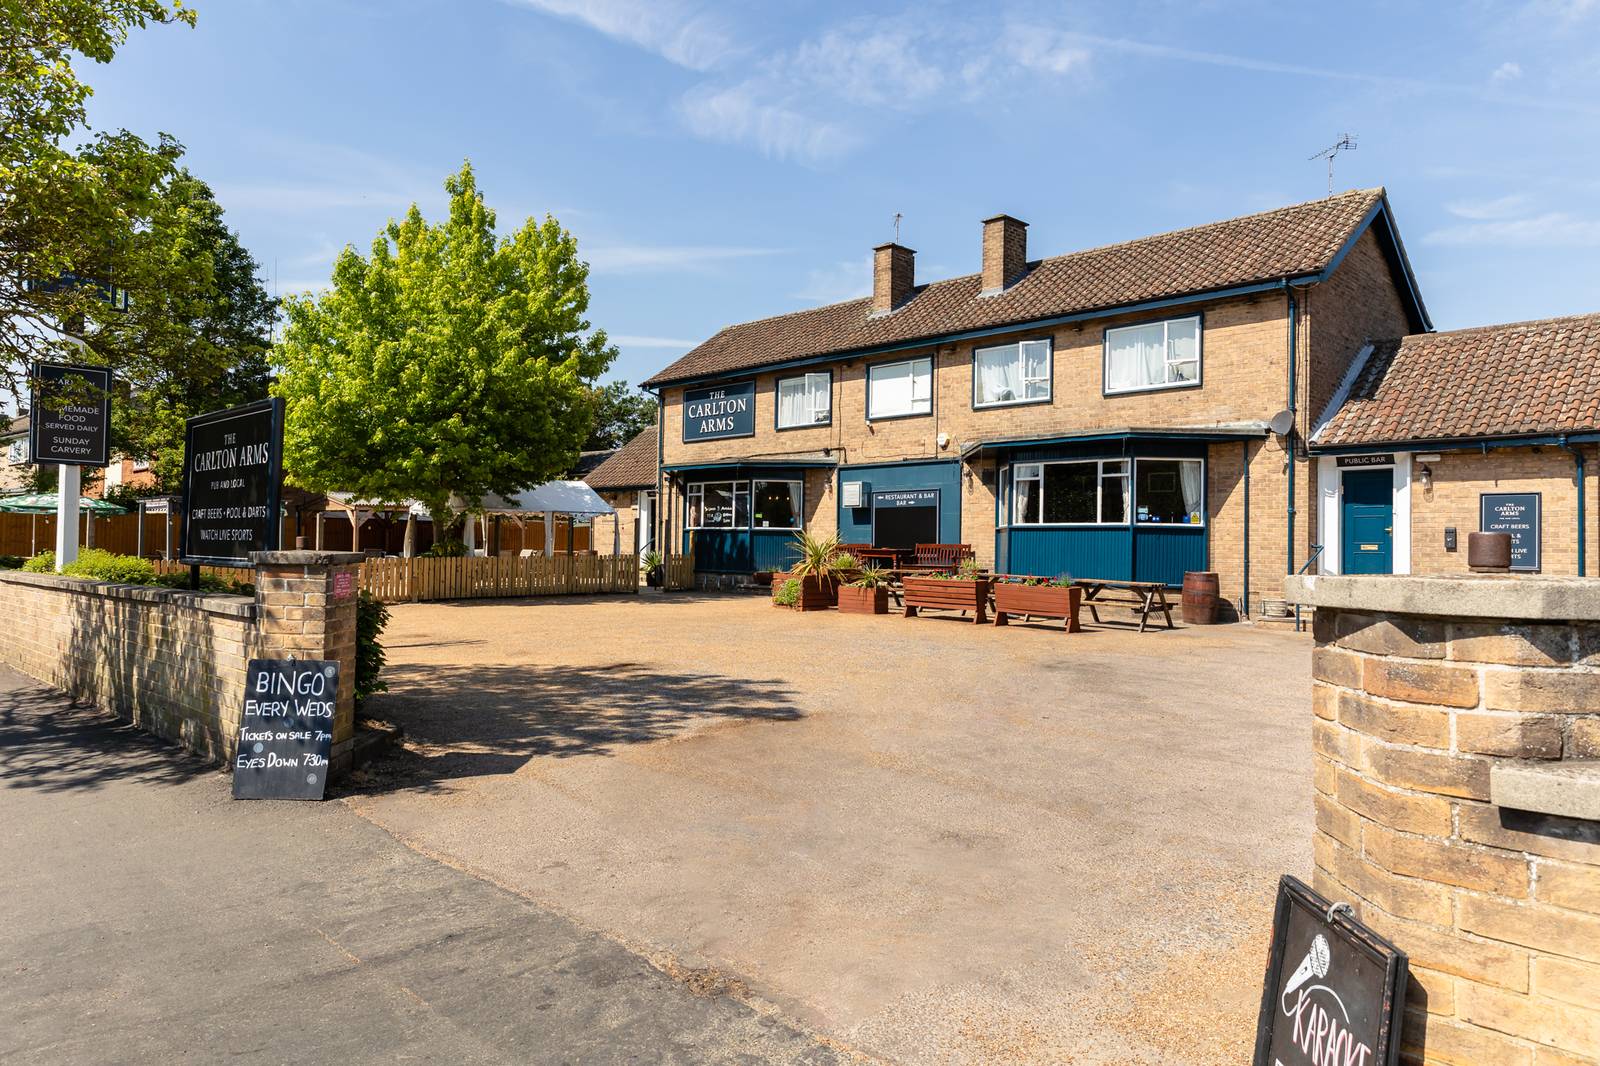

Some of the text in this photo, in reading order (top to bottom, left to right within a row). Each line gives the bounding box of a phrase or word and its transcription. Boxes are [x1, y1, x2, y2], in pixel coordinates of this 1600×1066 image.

[709, 390, 726, 400] THE
[62, 405, 100, 415] MEMADE
[688, 398, 747, 418] CARLTON
[58, 414, 86, 423] FOOD
[699, 416, 734, 433] ARMS
[45, 422, 99, 433] SERVED DAILY
[53, 436, 90, 445] SUNDAY
[224, 433, 236, 445] THE
[50, 445, 92, 455] CARVERY
[194, 442, 269, 472] CARLTON ARMS
[1344, 456, 1386, 465] PUBLIC BAR
[219, 480, 230, 489] AND
[230, 479, 245, 489] LOCAL
[192, 508, 207, 520] CRAFT
[207, 507, 223, 519] BEERS
[226, 507, 241, 519] POOL
[247, 505, 266, 518] DARTS
[200, 529, 253, 541] WATCH LIVE SPORTS
[255, 670, 325, 696] BINGO
[245, 698, 334, 718] EVERY WEDS
[240, 726, 274, 741] TICKETS
[275, 732, 288, 740] ON
[288, 731, 312, 740] SALE
[236, 753, 266, 769] EYES
[267, 752, 299, 768] DOWN
